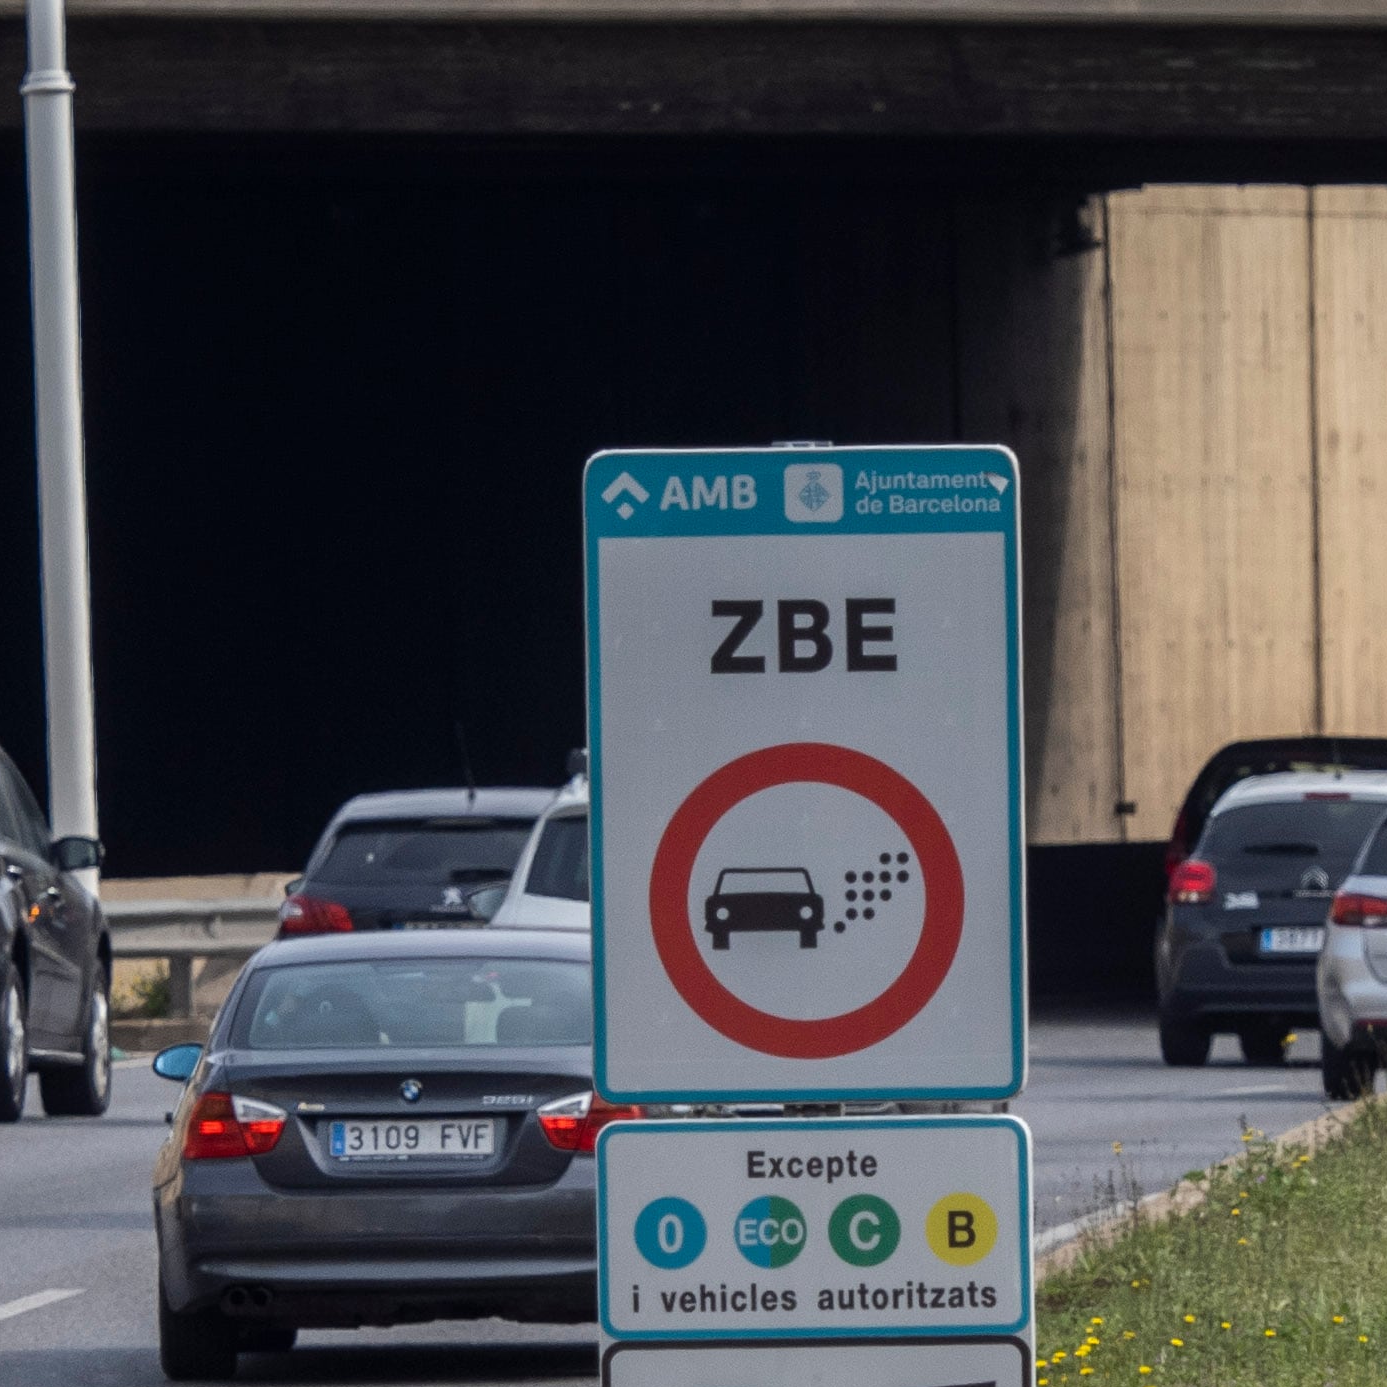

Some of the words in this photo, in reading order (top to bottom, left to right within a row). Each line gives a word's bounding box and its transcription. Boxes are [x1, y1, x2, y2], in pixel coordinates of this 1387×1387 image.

[659, 474, 758, 511] AMB
[855, 470, 988, 495] Ajuntament
[856, 496, 883, 514] de
[889, 494, 1001, 514] Barcelona
[710, 598, 898, 674] ZBE
[349, 1125, 420, 1150] 3109
[440, 1124, 490, 1149] FVF
[747, 1150, 878, 1183] Excepte
[738, 1218, 804, 1246] ECO
[849, 1211, 881, 1251] C
[947, 1210, 977, 1249] B
[632, 1284, 640, 1313] i
[660, 1283, 798, 1312] vehicles
[817, 1281, 997, 1310] autoritzats
